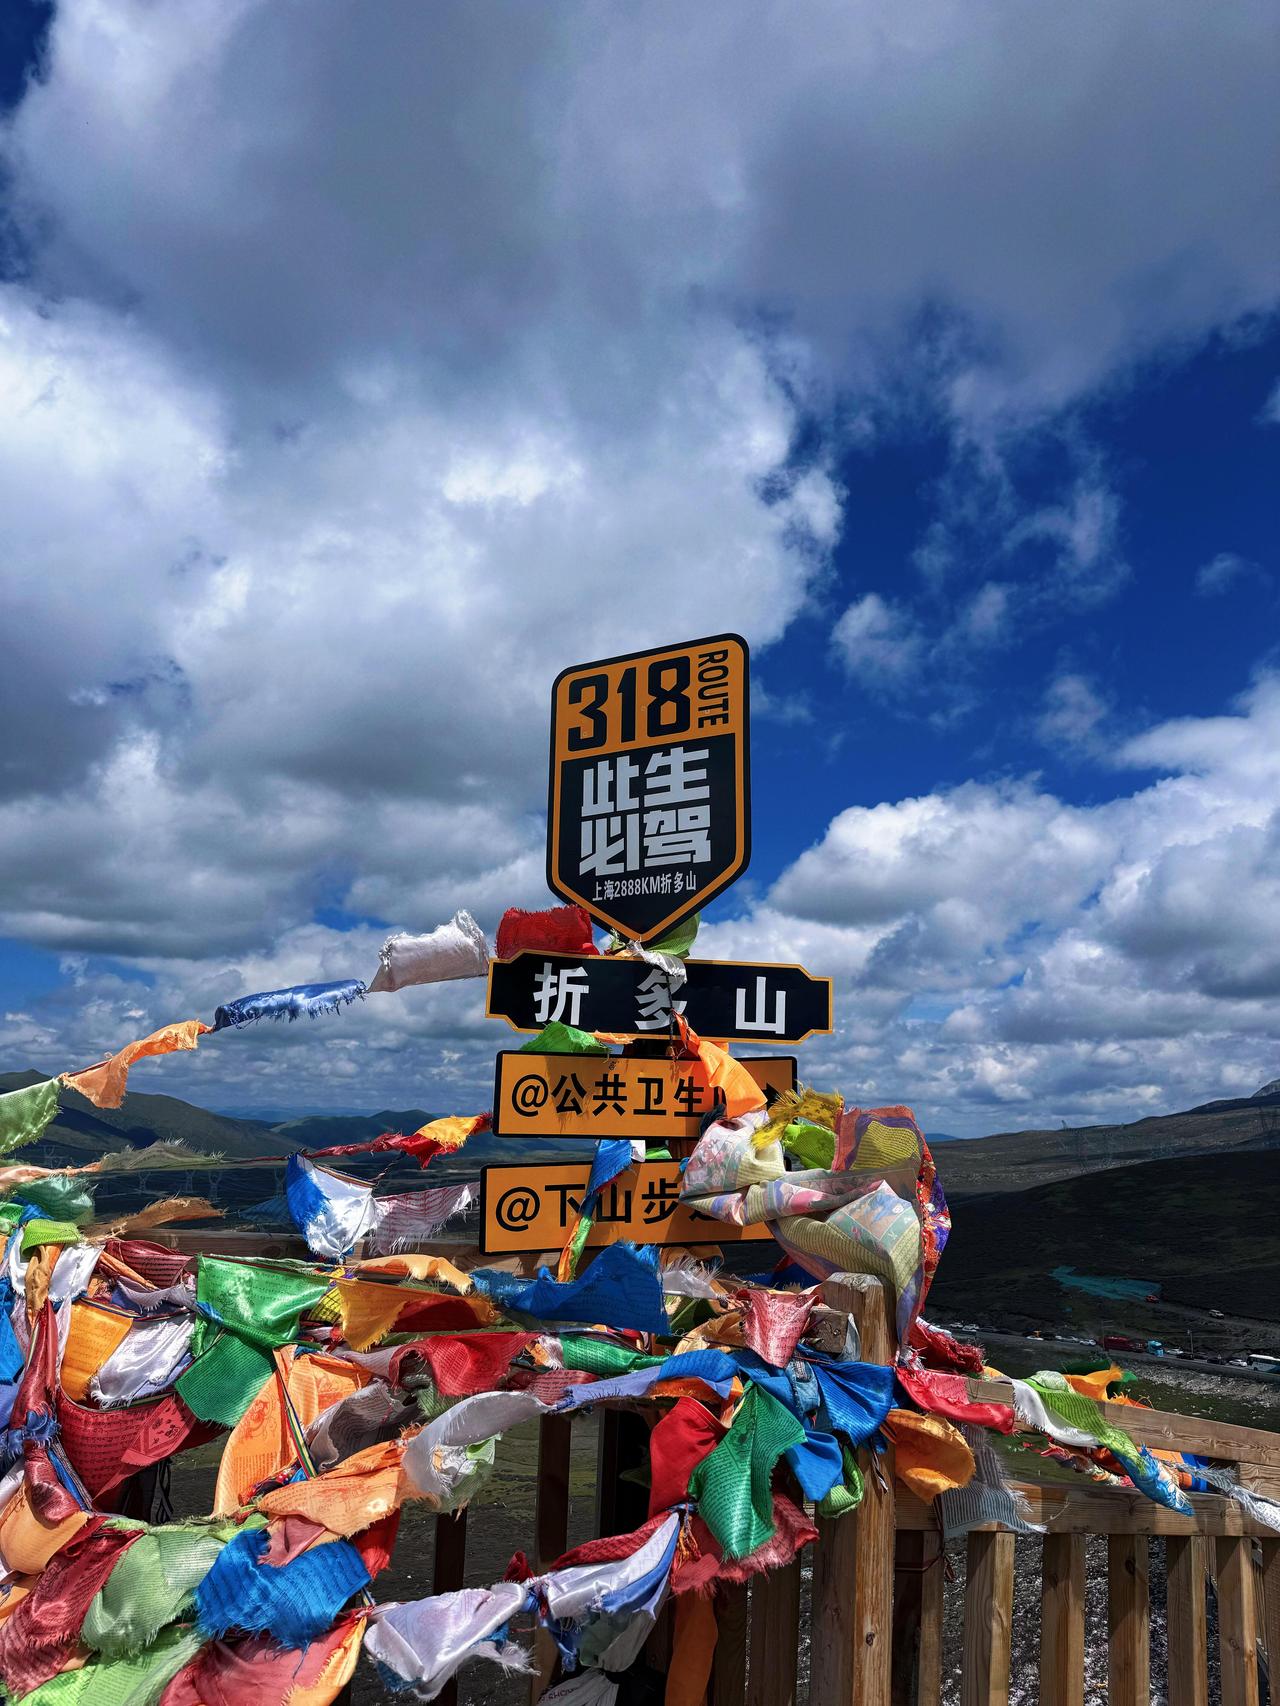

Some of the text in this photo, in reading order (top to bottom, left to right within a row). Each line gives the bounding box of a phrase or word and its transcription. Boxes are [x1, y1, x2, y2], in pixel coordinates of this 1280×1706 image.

[567, 655, 691, 752] 318
[697, 649, 729, 729] ROUTE
[581, 747, 711, 817] 此生
[579, 804, 712, 876] 必驾
[592, 870, 697, 902] 上海2888KM折多山
[533, 961, 787, 1035] 折多山
[511, 1073, 726, 1118] @公共卫生
[495, 1178, 715, 1232] @下山步
